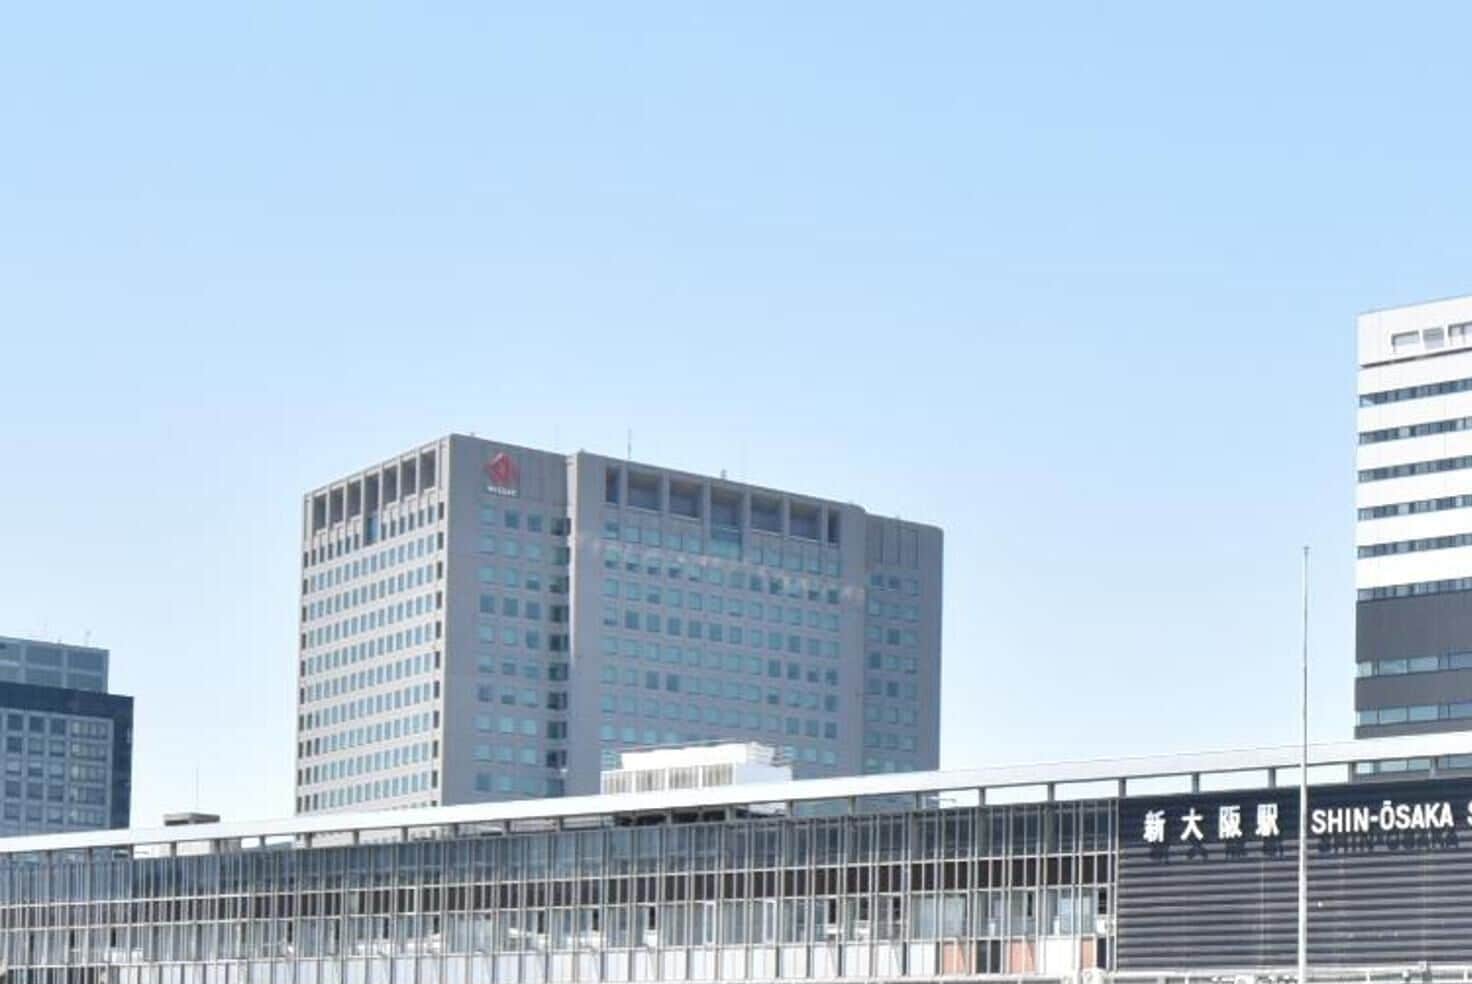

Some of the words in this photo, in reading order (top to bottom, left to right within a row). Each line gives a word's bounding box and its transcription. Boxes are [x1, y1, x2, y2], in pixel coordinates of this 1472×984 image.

[1143, 804, 1280, 842] 新大阪駅
[1311, 801, 1455, 836] SHIN-ŌSAKA
